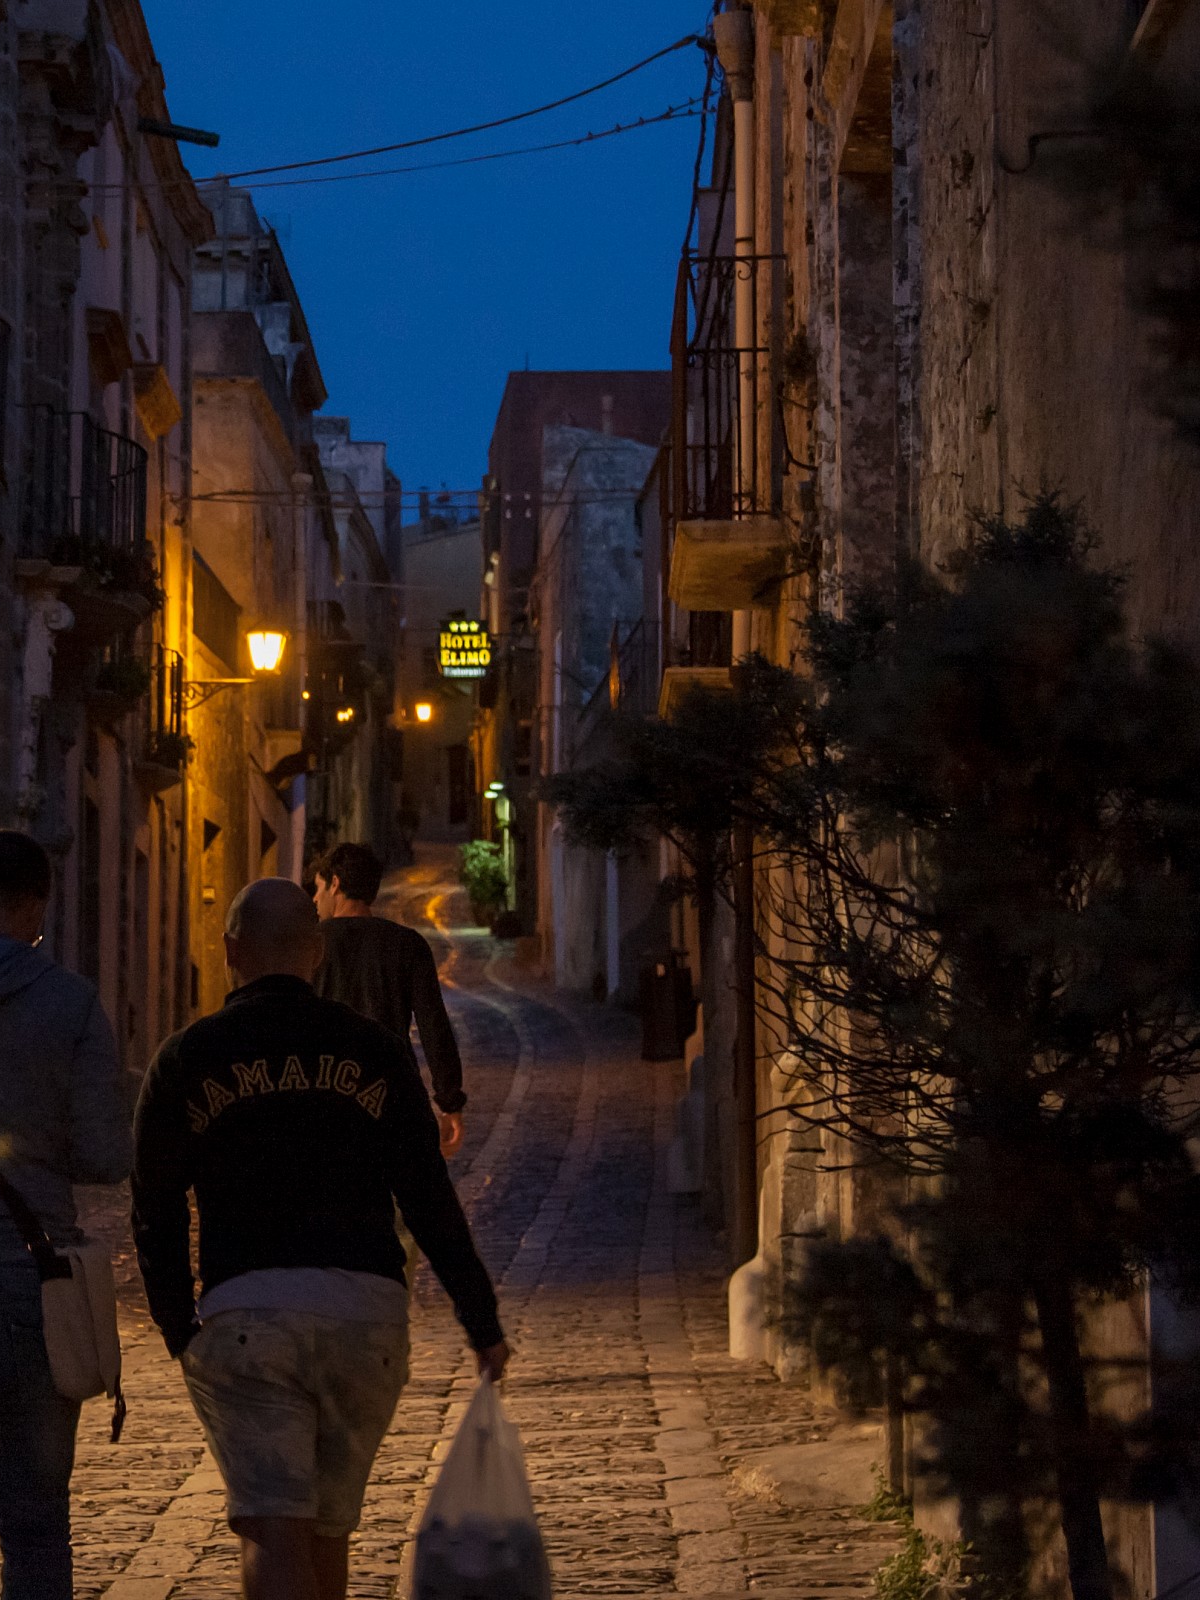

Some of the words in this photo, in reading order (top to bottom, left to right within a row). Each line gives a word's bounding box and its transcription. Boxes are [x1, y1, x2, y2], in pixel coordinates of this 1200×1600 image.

[440, 632, 491, 649] HOTEL
[441, 648, 491, 666] ELIMO
[186, 1054, 388, 1135] JAMAICA
